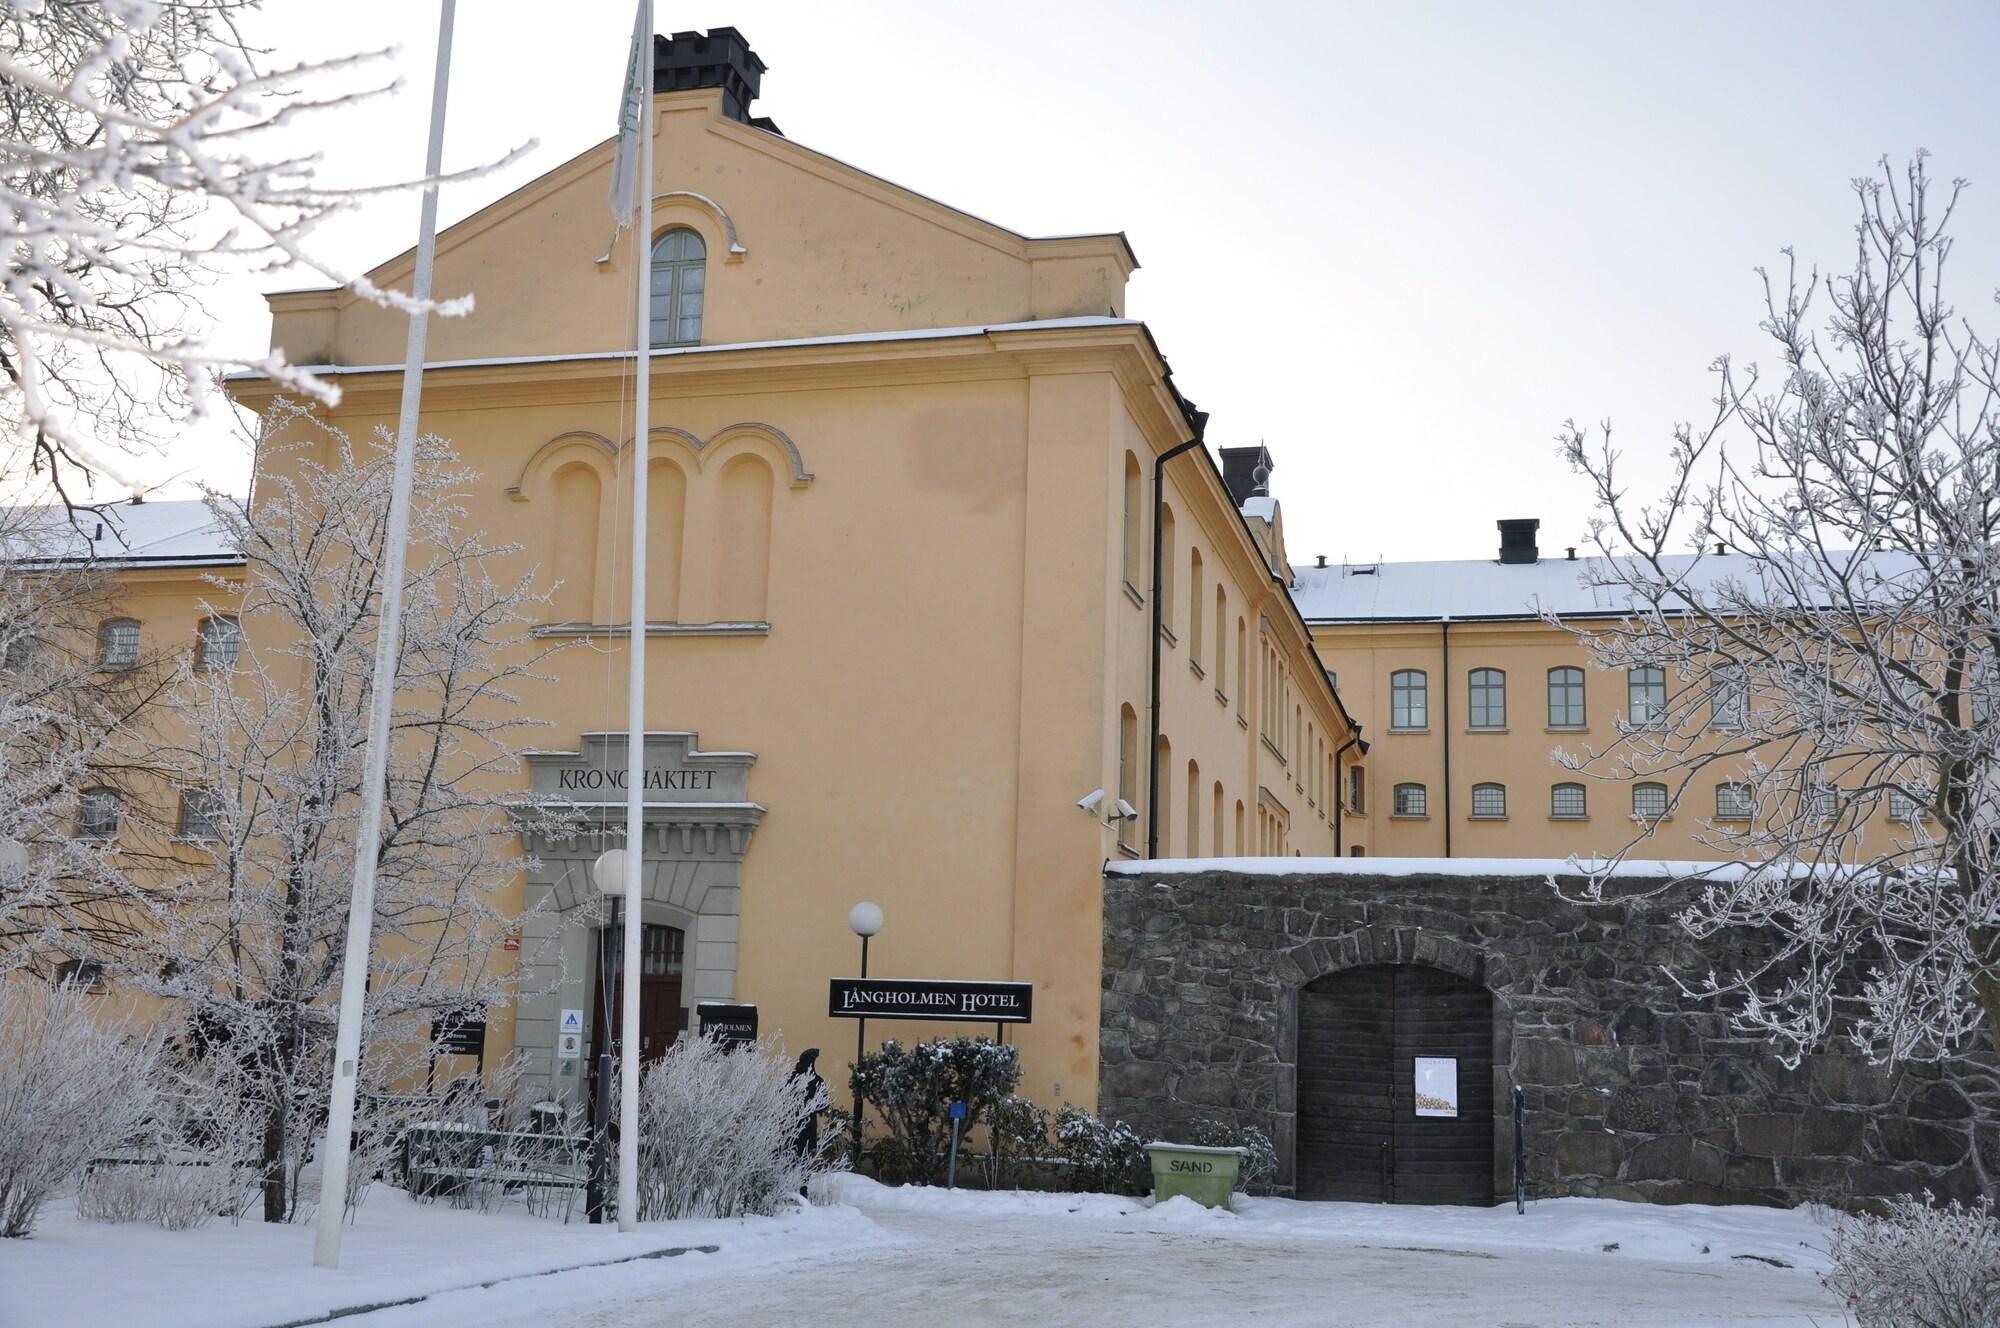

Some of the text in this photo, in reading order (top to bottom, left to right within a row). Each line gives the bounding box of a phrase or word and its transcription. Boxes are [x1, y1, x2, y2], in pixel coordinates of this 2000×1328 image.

[842, 987, 1020, 1012] LÅNGHOLMEN HOTEL
[1170, 1160, 1213, 1173] SAND
